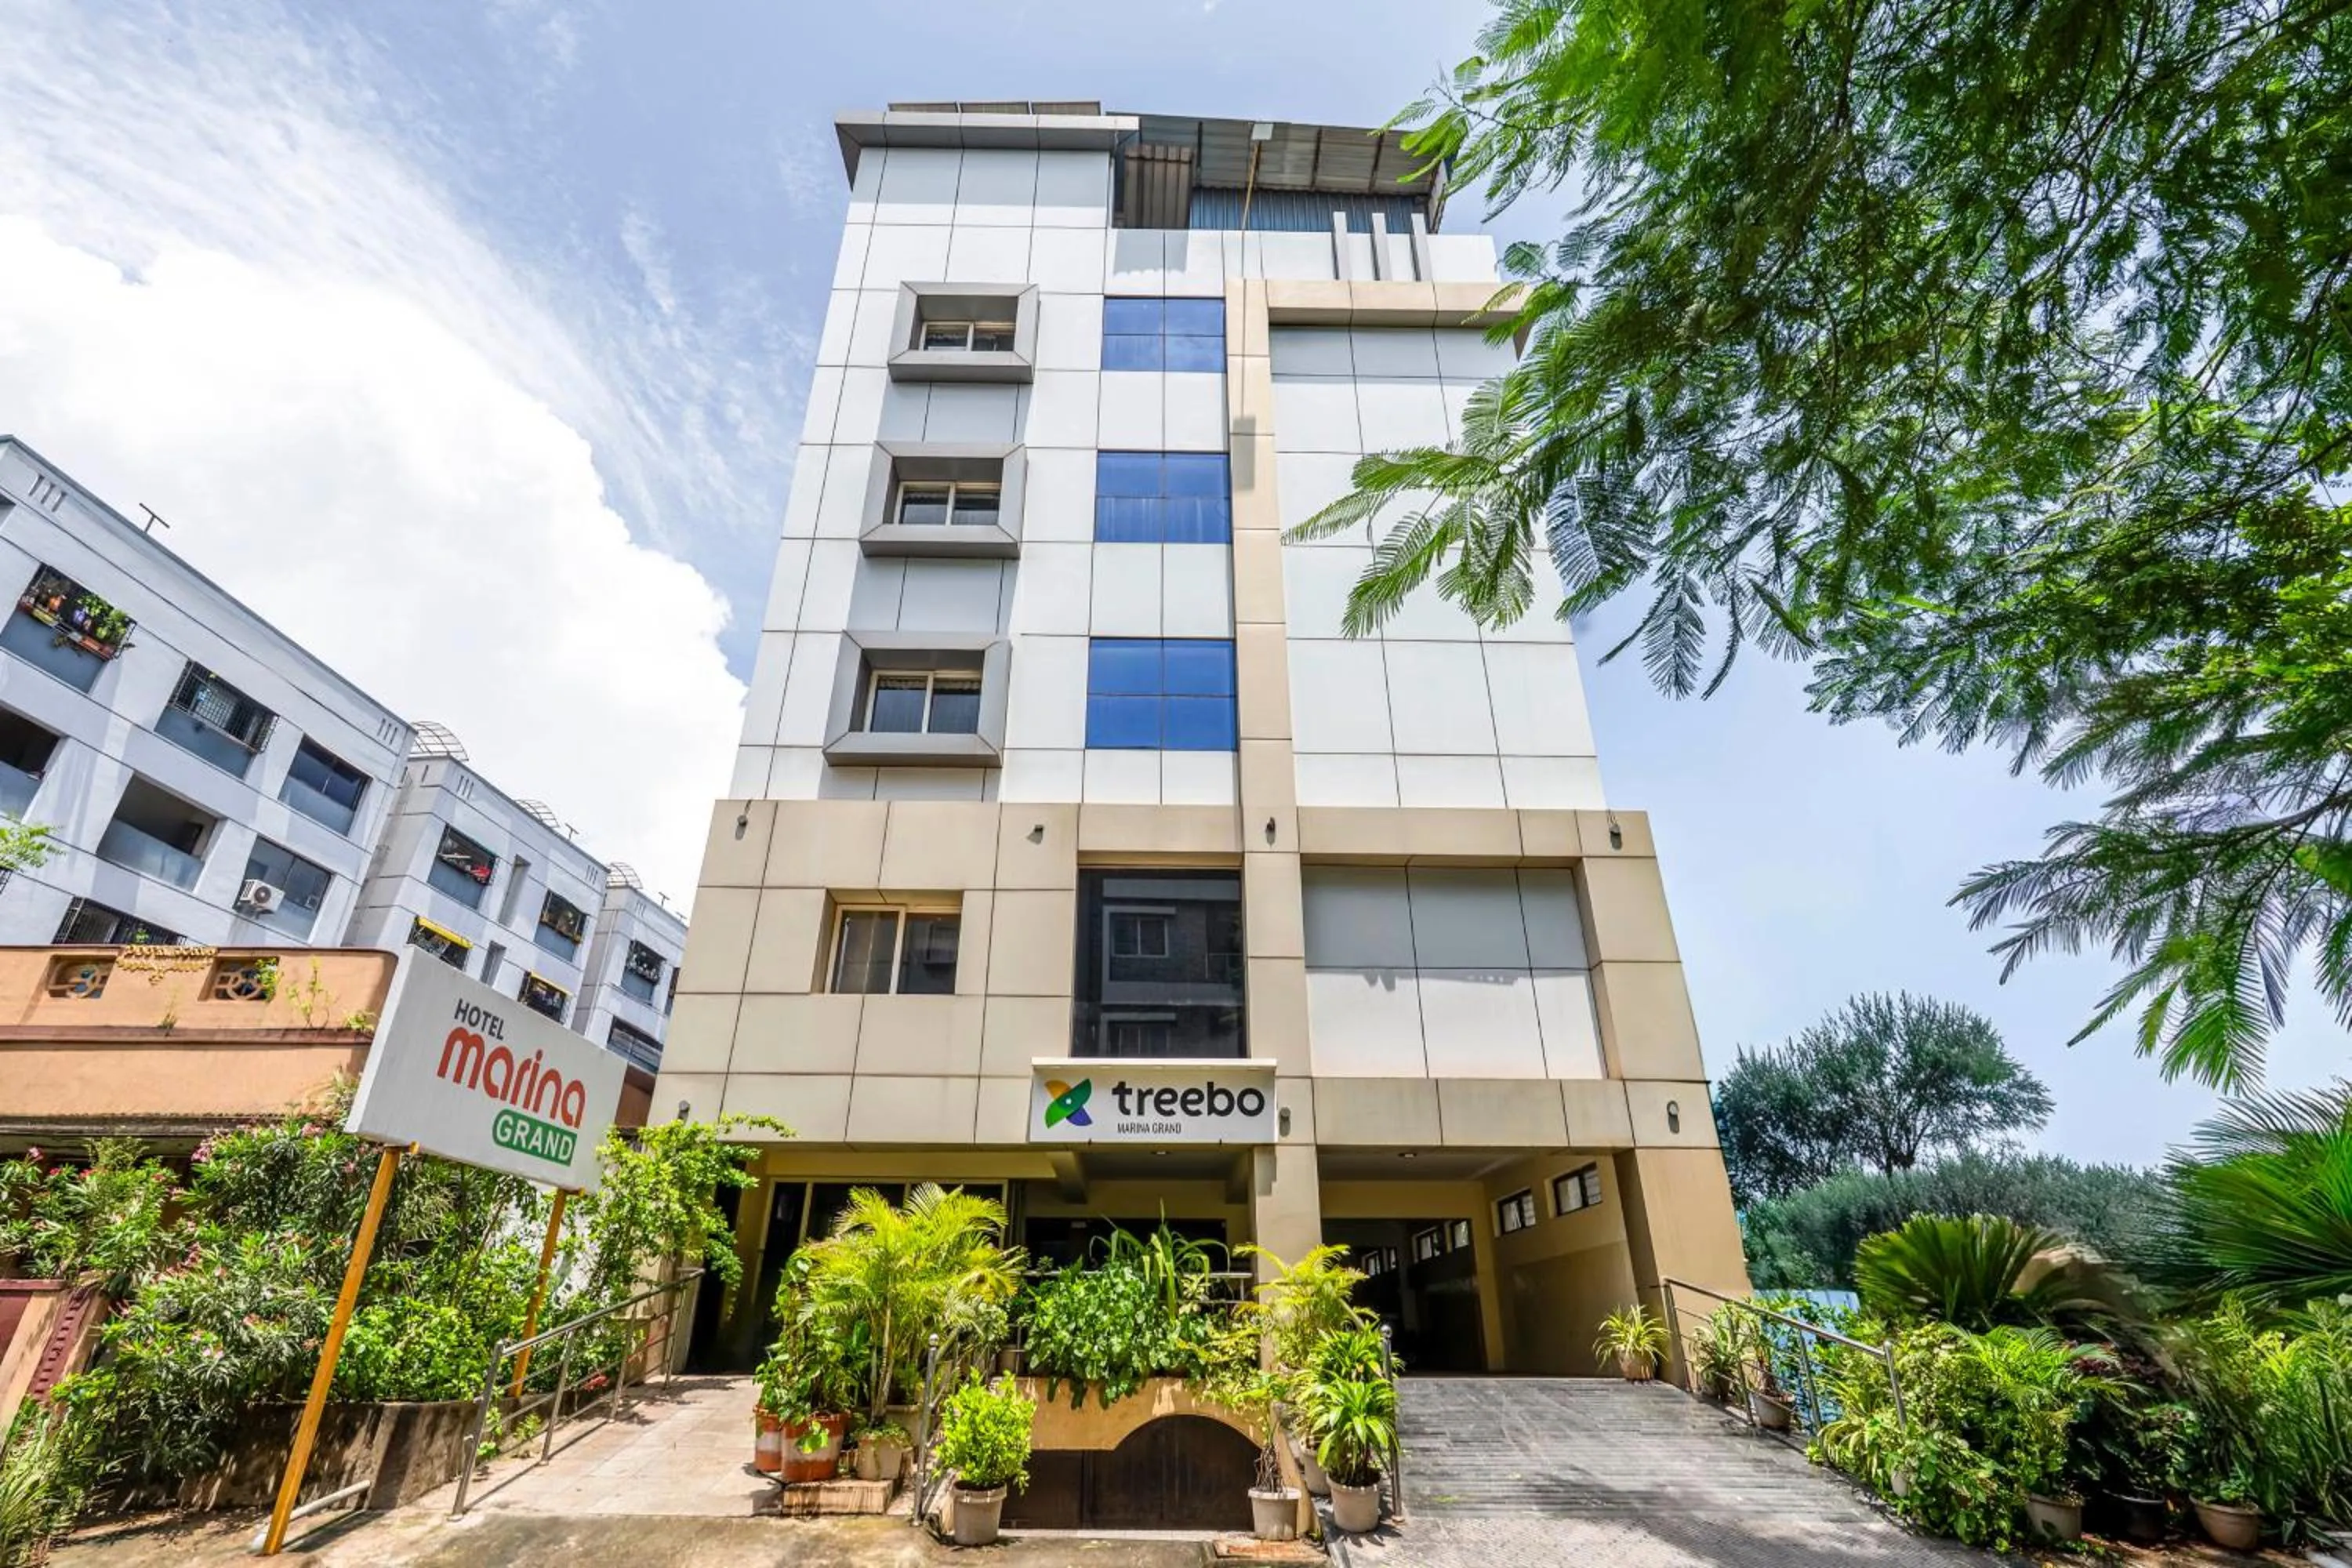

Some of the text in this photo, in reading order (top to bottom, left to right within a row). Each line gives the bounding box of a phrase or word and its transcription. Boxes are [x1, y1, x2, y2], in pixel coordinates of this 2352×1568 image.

[455, 998, 505, 1040] HOTEL
[437, 1026, 586, 1129] marina
[1112, 1081, 1265, 1117] treebo
[495, 1114, 574, 1162] GRAND
[1117, 1122, 1181, 1134] MARINA GRAND
